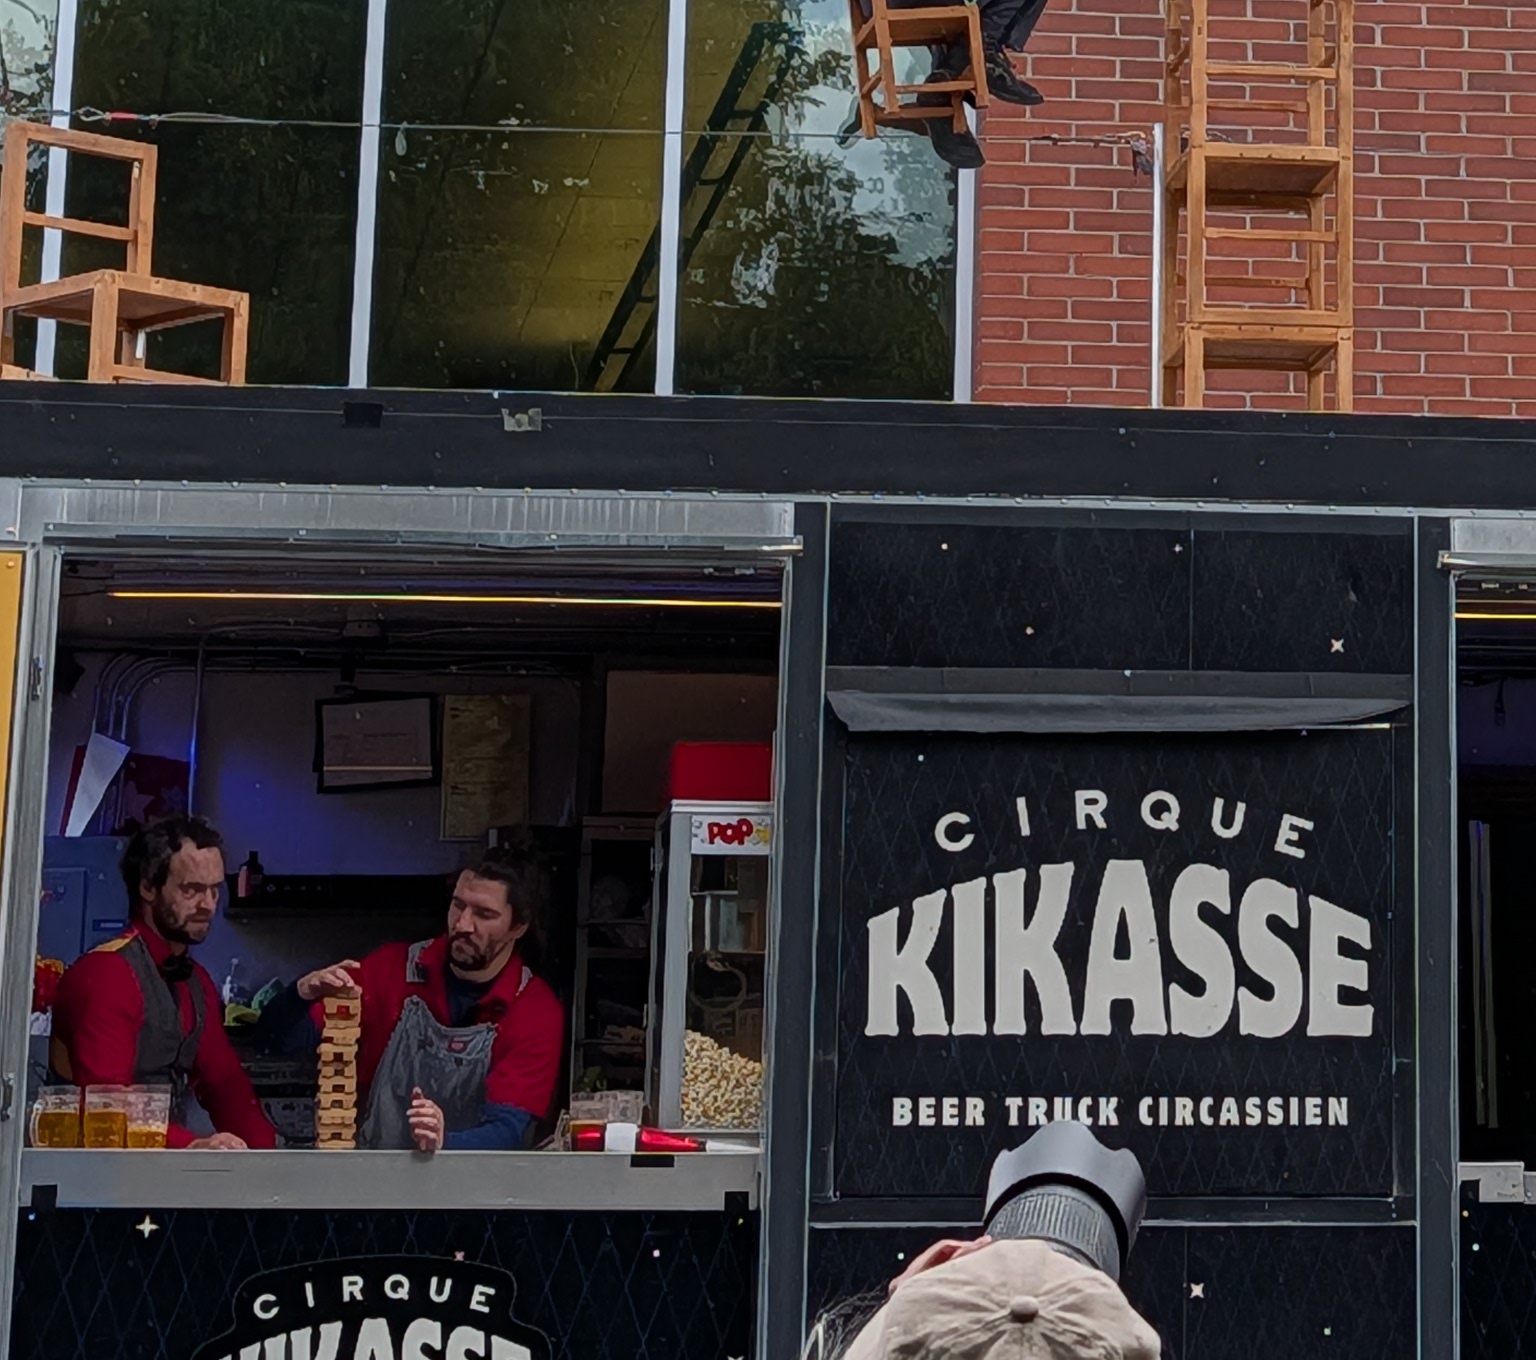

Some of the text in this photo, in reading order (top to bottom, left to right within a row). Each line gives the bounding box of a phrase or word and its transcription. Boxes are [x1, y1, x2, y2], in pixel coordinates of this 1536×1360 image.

[707, 818, 754, 846] POP
[934, 789, 1315, 858] CIRQUE
[864, 858, 1374, 1039] KIKASSE
[892, 1096, 1349, 1127] BEER TRUCK CIRCASSIEN
[253, 1273, 496, 1314] CIRQUE
